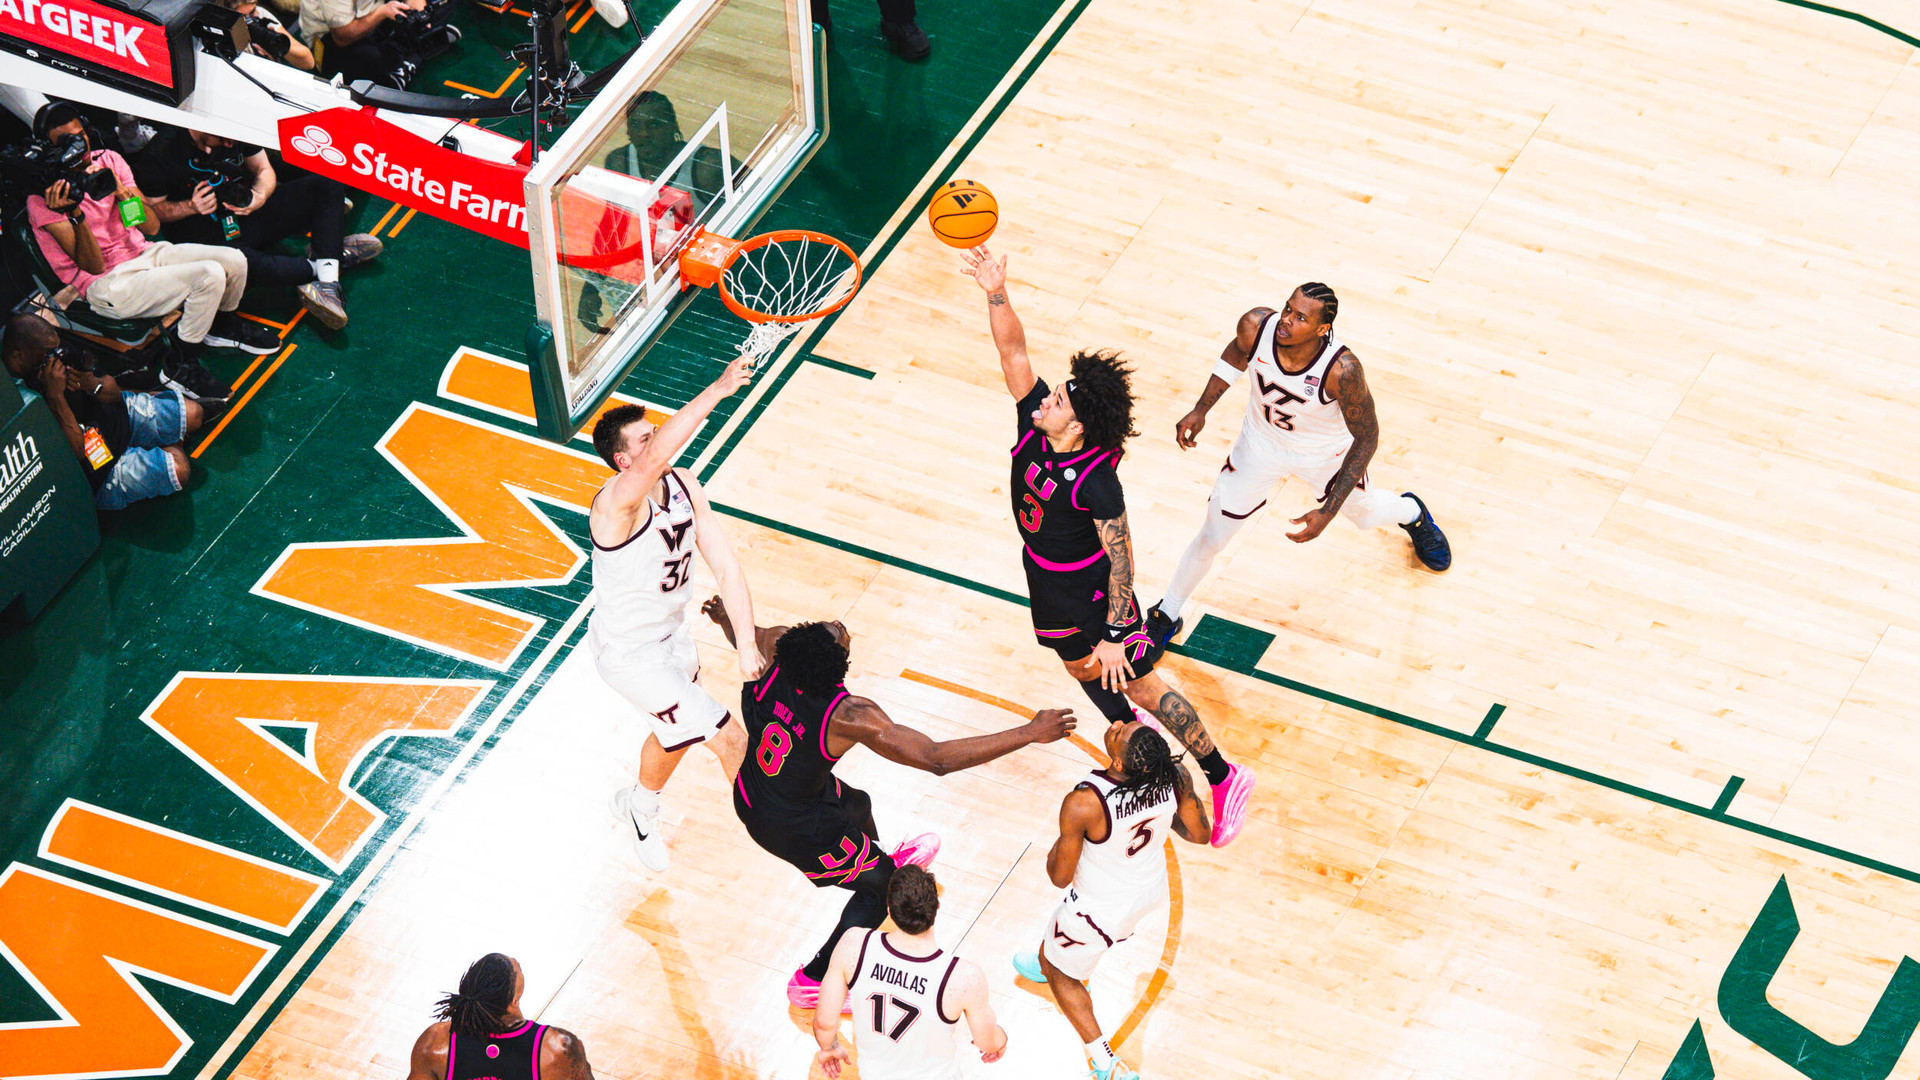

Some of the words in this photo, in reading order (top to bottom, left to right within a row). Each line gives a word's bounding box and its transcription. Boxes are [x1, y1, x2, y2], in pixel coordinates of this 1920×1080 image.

[351, 143, 446, 205] State
[1261, 402, 1297, 432] 13
[20, 461, 43, 490] SYSTEM
[2, 503, 51, 558] CADILLAC
[1019, 493, 1044, 534] 3
[659, 549, 693, 595] 32
[756, 721, 793, 777] 8
[792, 722, 806, 741] JR.
[1125, 815, 1161, 859] 3
[870, 963, 928, 995] AVDALAS
[866, 992, 922, 1043] 17
